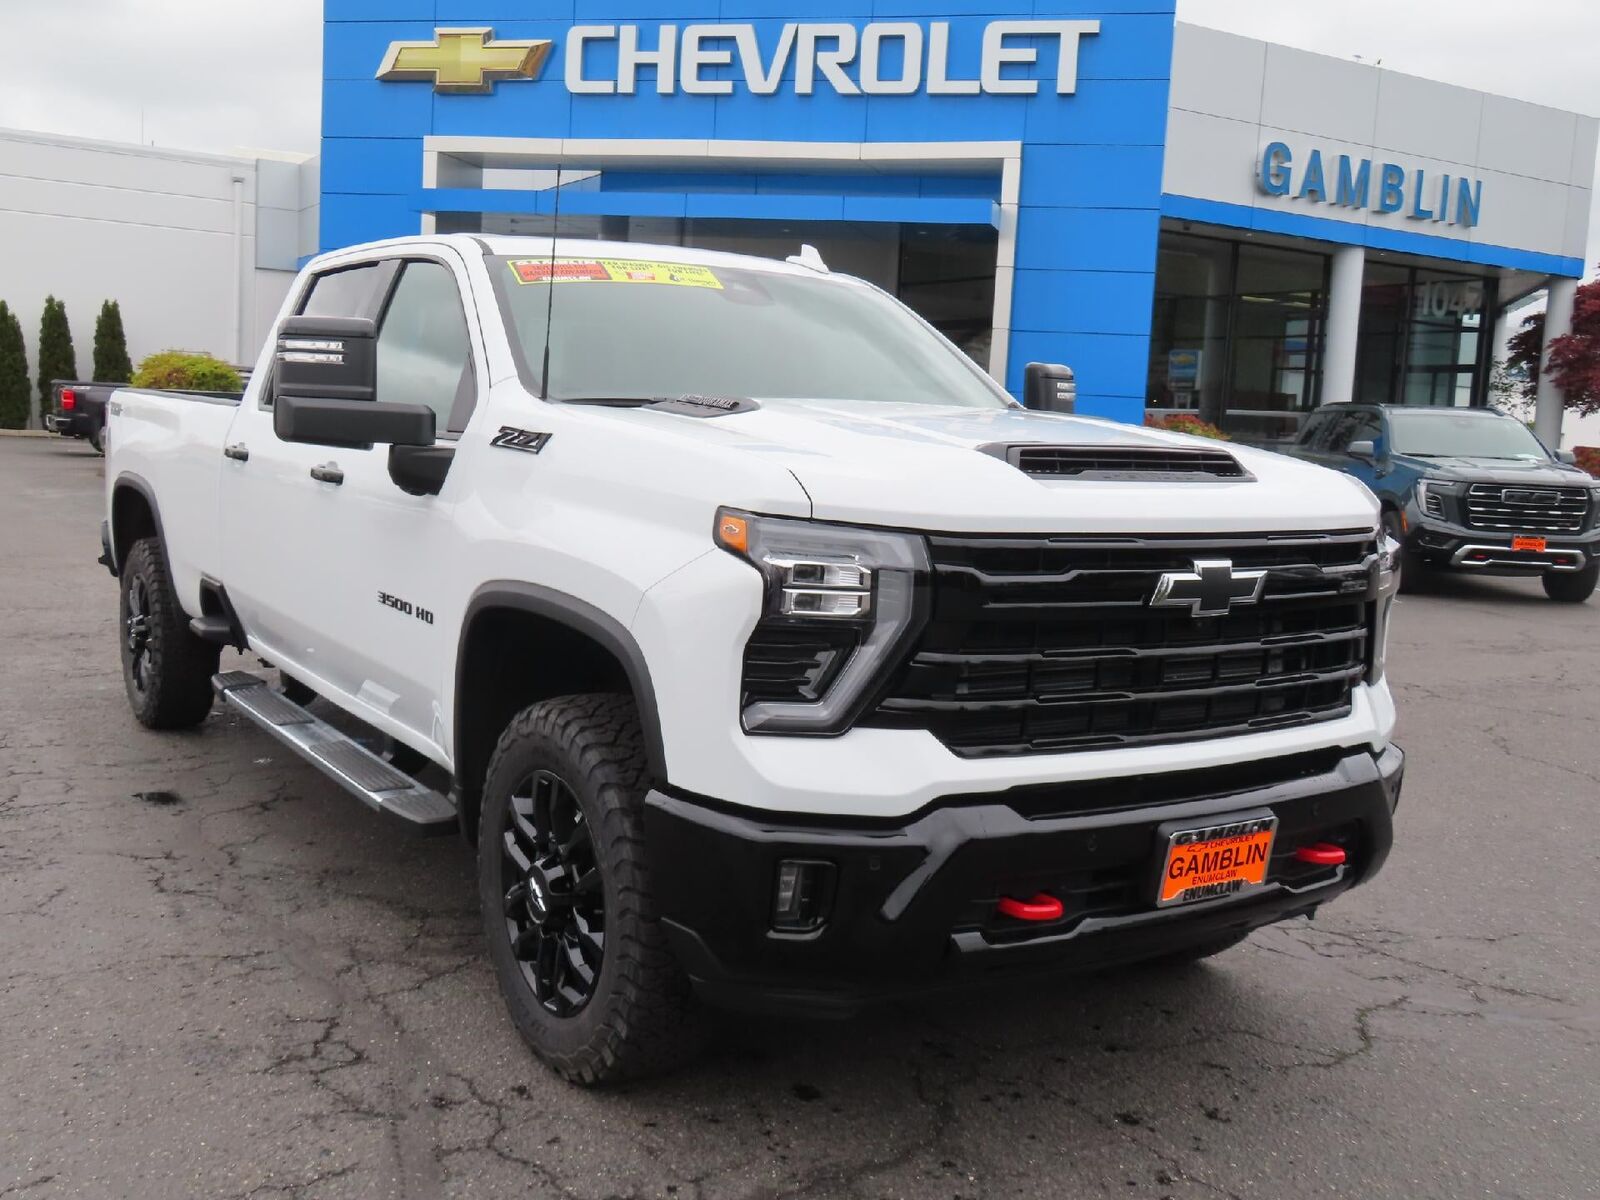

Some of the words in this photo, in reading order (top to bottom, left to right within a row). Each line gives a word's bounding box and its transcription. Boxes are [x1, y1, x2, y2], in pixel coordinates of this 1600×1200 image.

[565, 20, 1101, 96] CHEVROLET
[1260, 141, 1483, 228] GAMBLIN
[1423, 281, 1484, 320] 1047
[489, 425, 554, 455] Z71
[377, 590, 413, 615] 3500
[415, 606, 434, 625] HD
[1209, 835, 1256, 849] CHEVROLET
[1168, 842, 1268, 880] GAMBLIN
[1191, 869, 1238, 885] ENUMCLAW
[1182, 879, 1245, 902] ENUMCLAW
